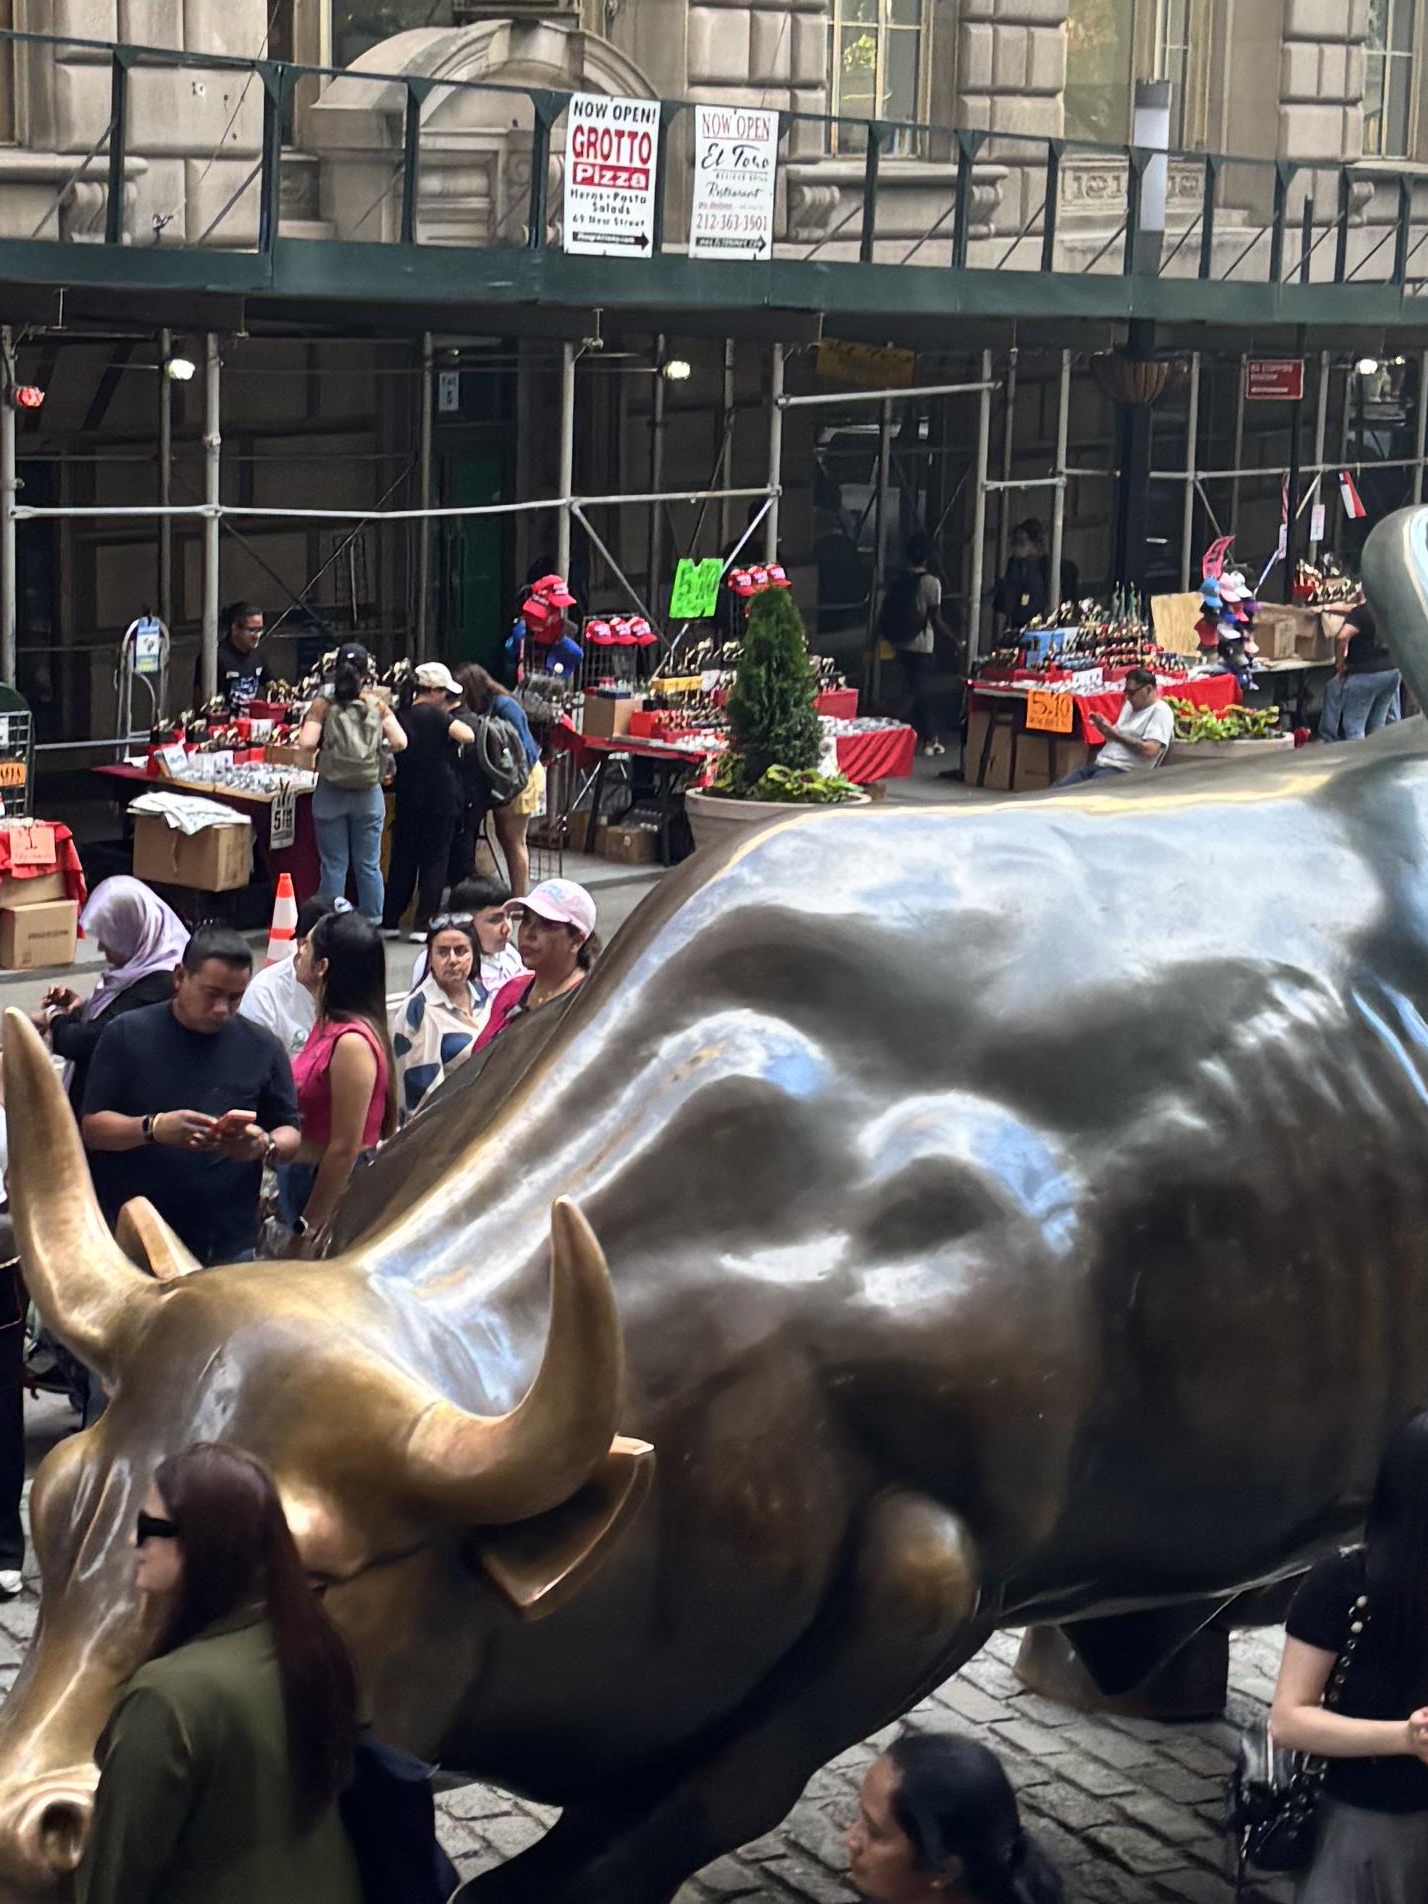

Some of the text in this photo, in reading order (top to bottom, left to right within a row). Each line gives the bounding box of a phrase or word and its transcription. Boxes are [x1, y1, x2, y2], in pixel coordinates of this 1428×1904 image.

[574, 100, 656, 124] NOW OPEN!
[703, 113, 770, 140] NOW OPEN
[572, 124, 652, 165] GROTTO
[701, 142, 725, 169] El
[575, 164, 647, 188] Pizza
